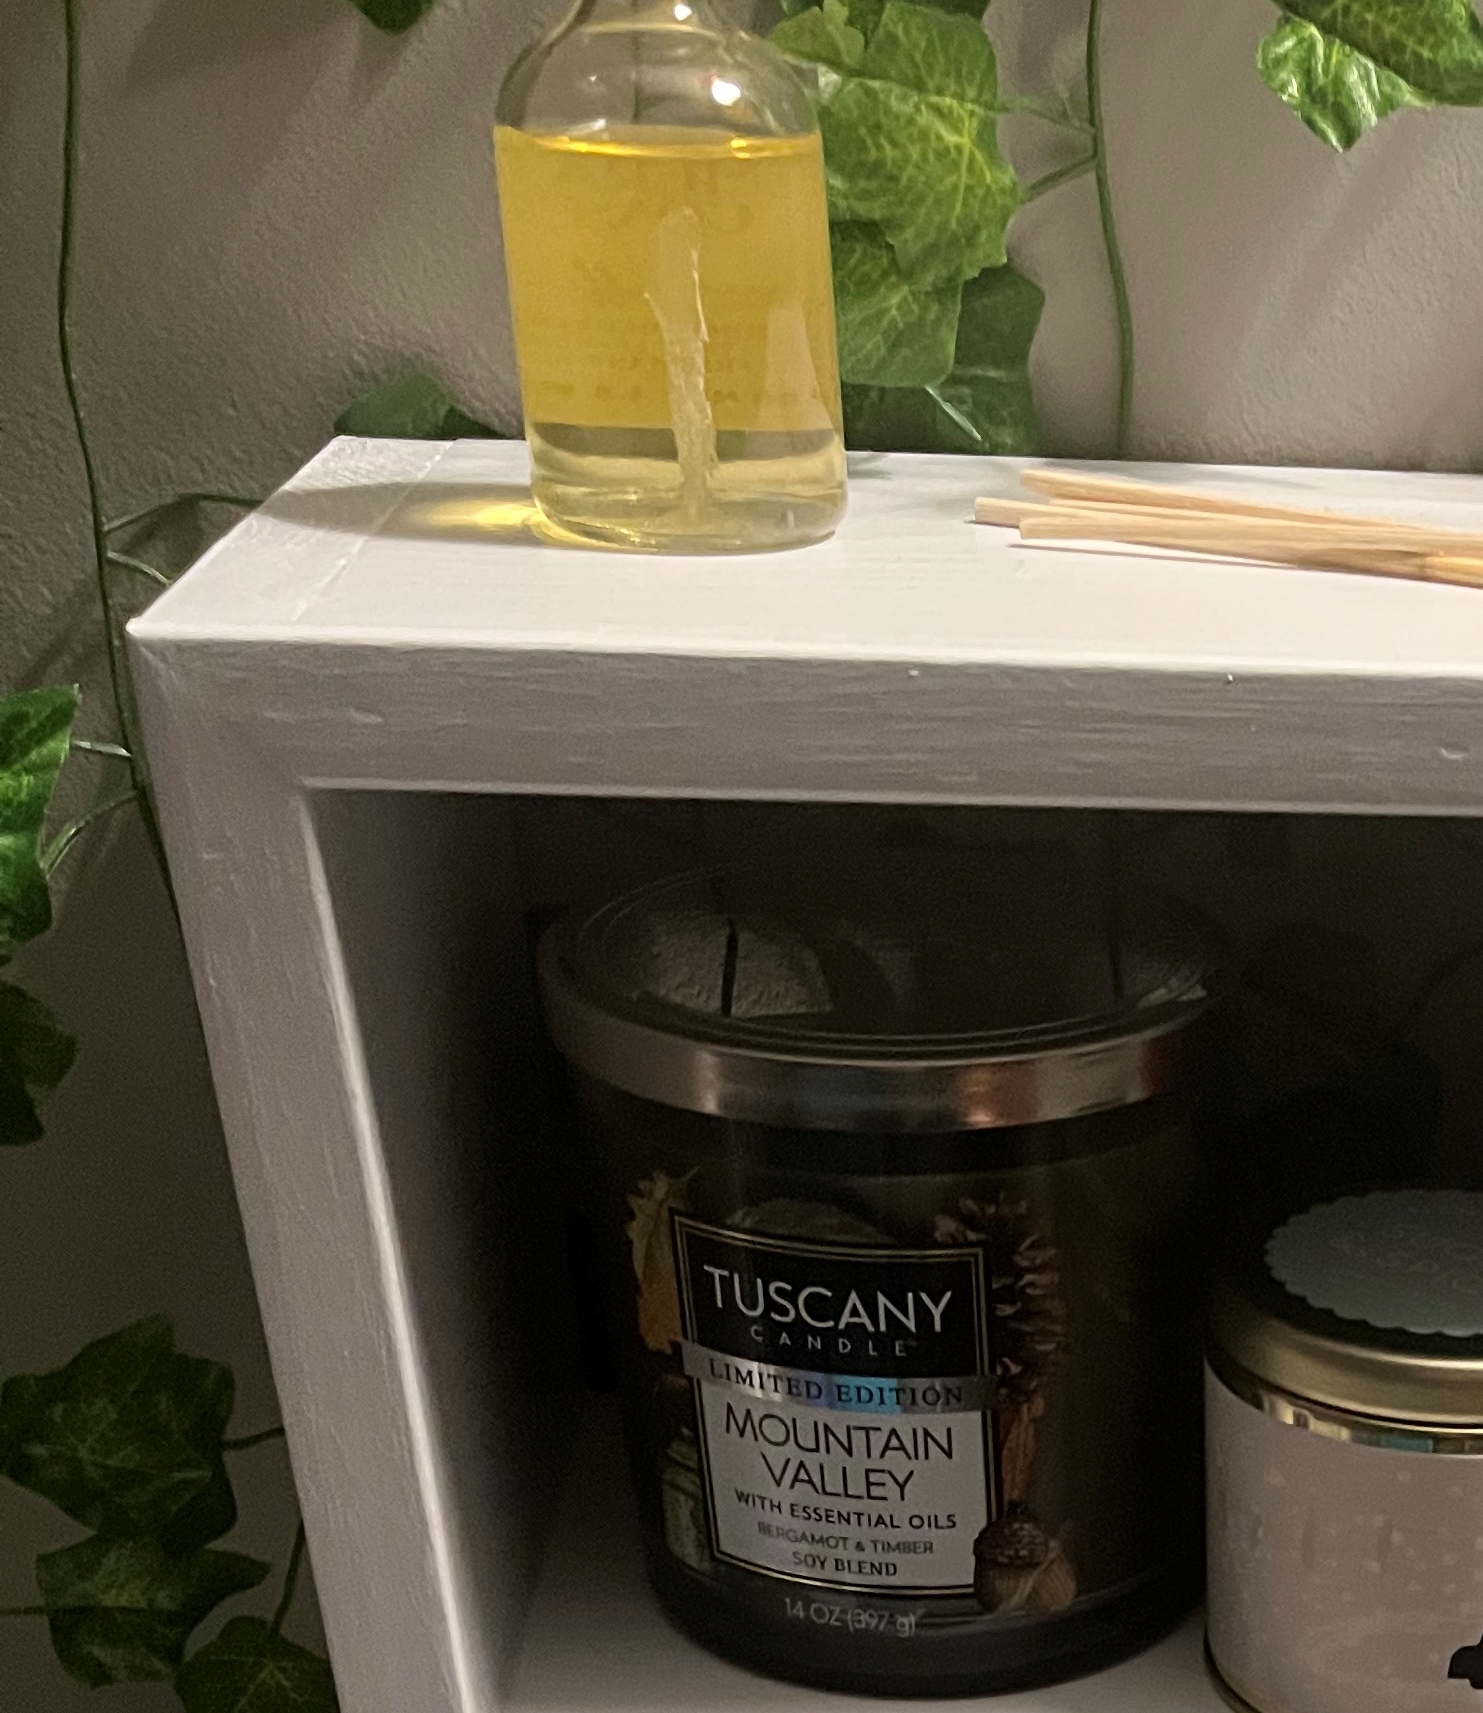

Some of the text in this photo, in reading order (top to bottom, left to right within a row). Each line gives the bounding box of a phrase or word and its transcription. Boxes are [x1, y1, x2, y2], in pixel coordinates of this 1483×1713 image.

[702, 1264, 953, 1334] TUSCANY
[749, 1325, 908, 1357] CANDLE
[708, 1357, 964, 1408] LIMITED EDITION
[725, 1401, 954, 1461] MOUNTAIN
[759, 1451, 915, 1502] VALLEY
[733, 1488, 958, 1531] WITH ESSENTIAL OILS
[756, 1520, 935, 1555] BERGAMOT & TIMBER
[792, 1551, 898, 1577] SOY BLEND
[784, 1597, 805, 1620] 14
[809, 1602, 842, 1627] OZ
